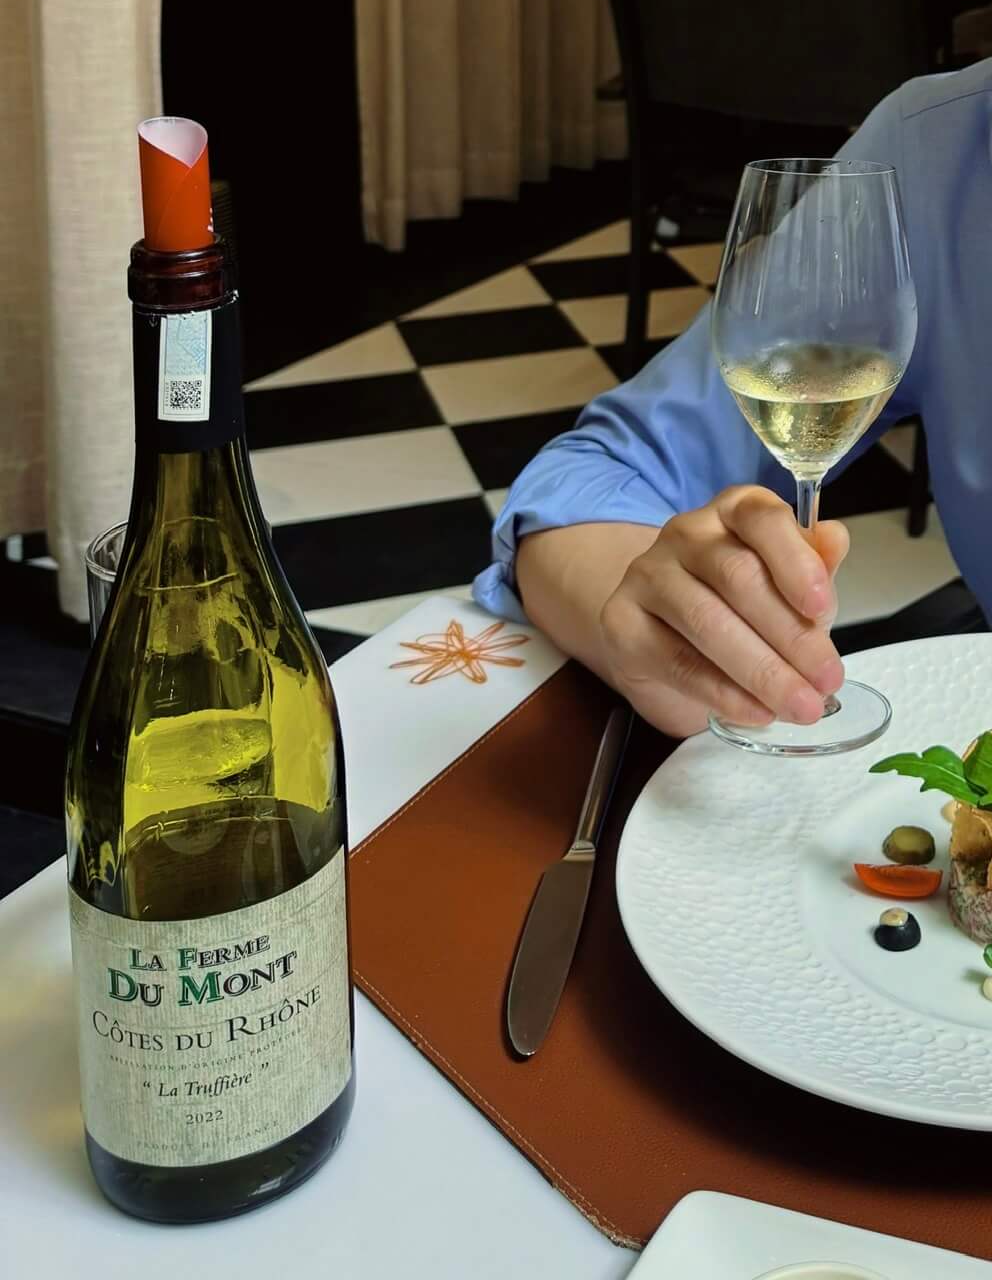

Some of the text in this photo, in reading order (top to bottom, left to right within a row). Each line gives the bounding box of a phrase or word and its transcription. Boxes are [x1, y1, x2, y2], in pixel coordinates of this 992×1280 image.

[130, 934, 271, 971] LA FERME
[108, 950, 298, 1007] DU MONT
[92, 985, 321, 1052] CÔTES DU RHÔNE
[158, 1082, 178, 1097] La
[184, 1071, 253, 1098] Truffière
[185, 1110, 224, 1125] 2022
